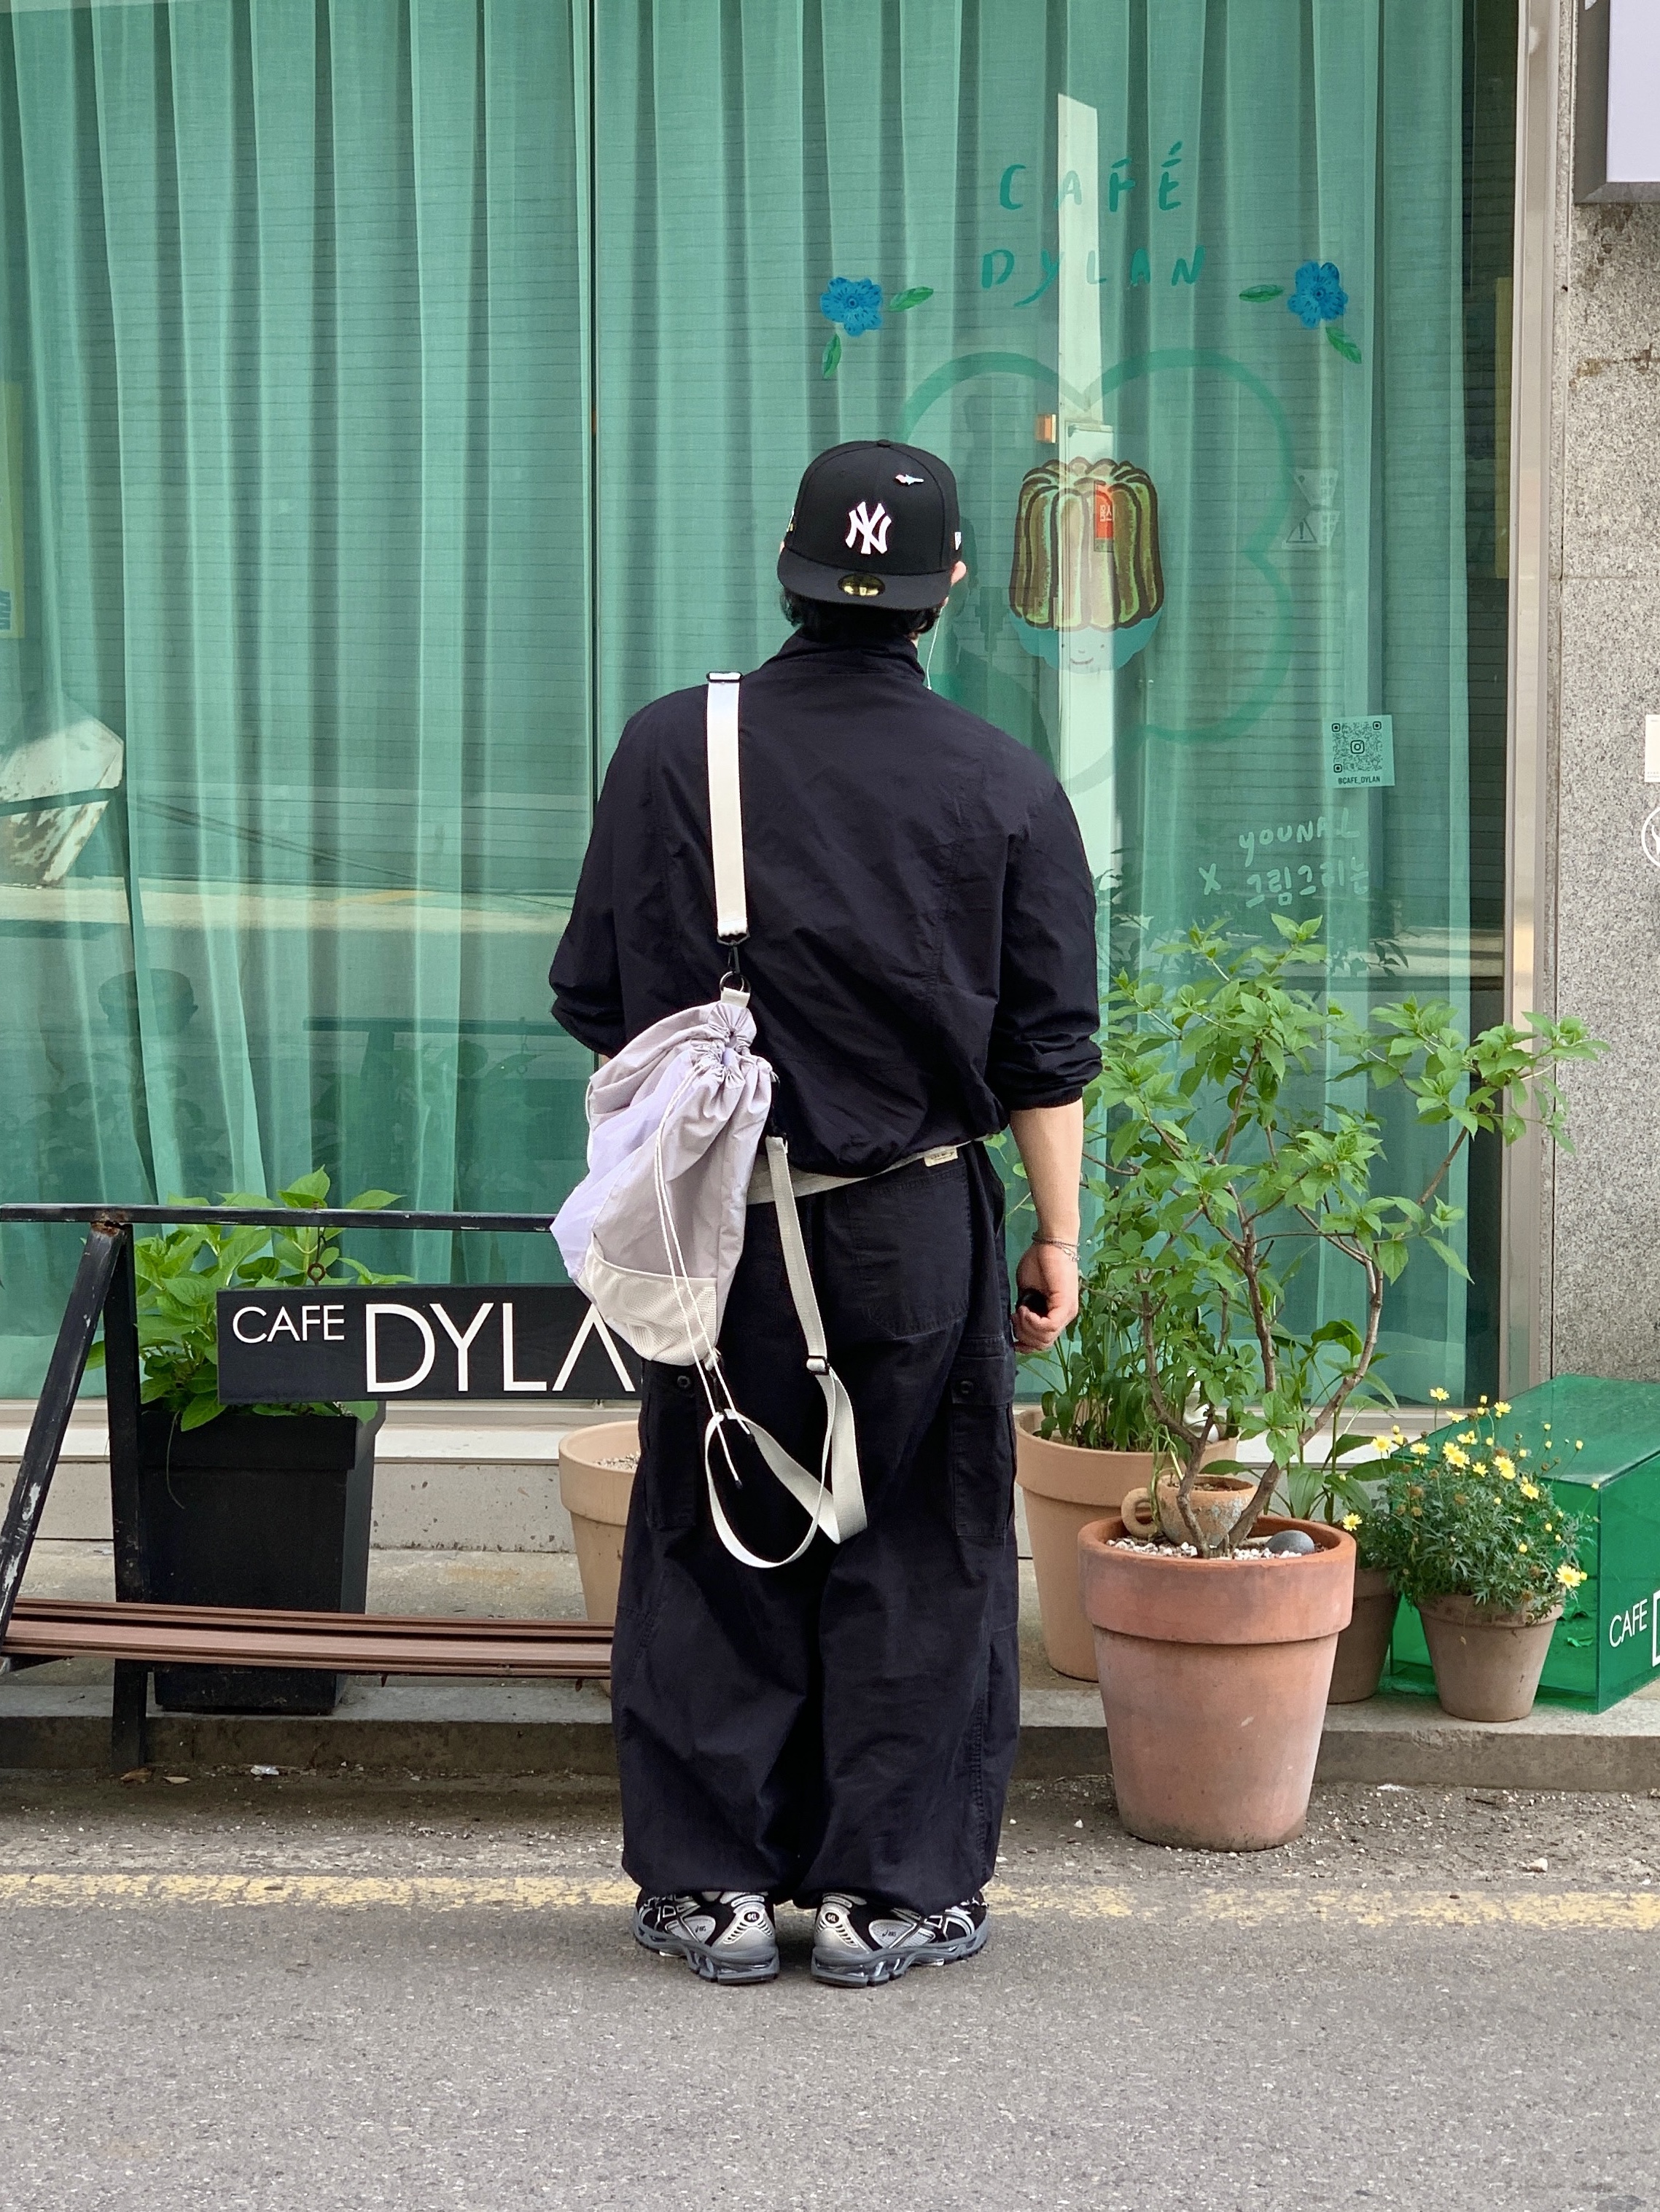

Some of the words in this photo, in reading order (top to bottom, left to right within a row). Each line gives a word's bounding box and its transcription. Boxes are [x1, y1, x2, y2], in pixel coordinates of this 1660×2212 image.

[846, 502, 892, 554] NY
[1338, 775, 1380, 785] @CAFE_DYLAN
[233, 1305, 345, 1343] CAFE
[1609, 1598, 1648, 1648] CAFE
